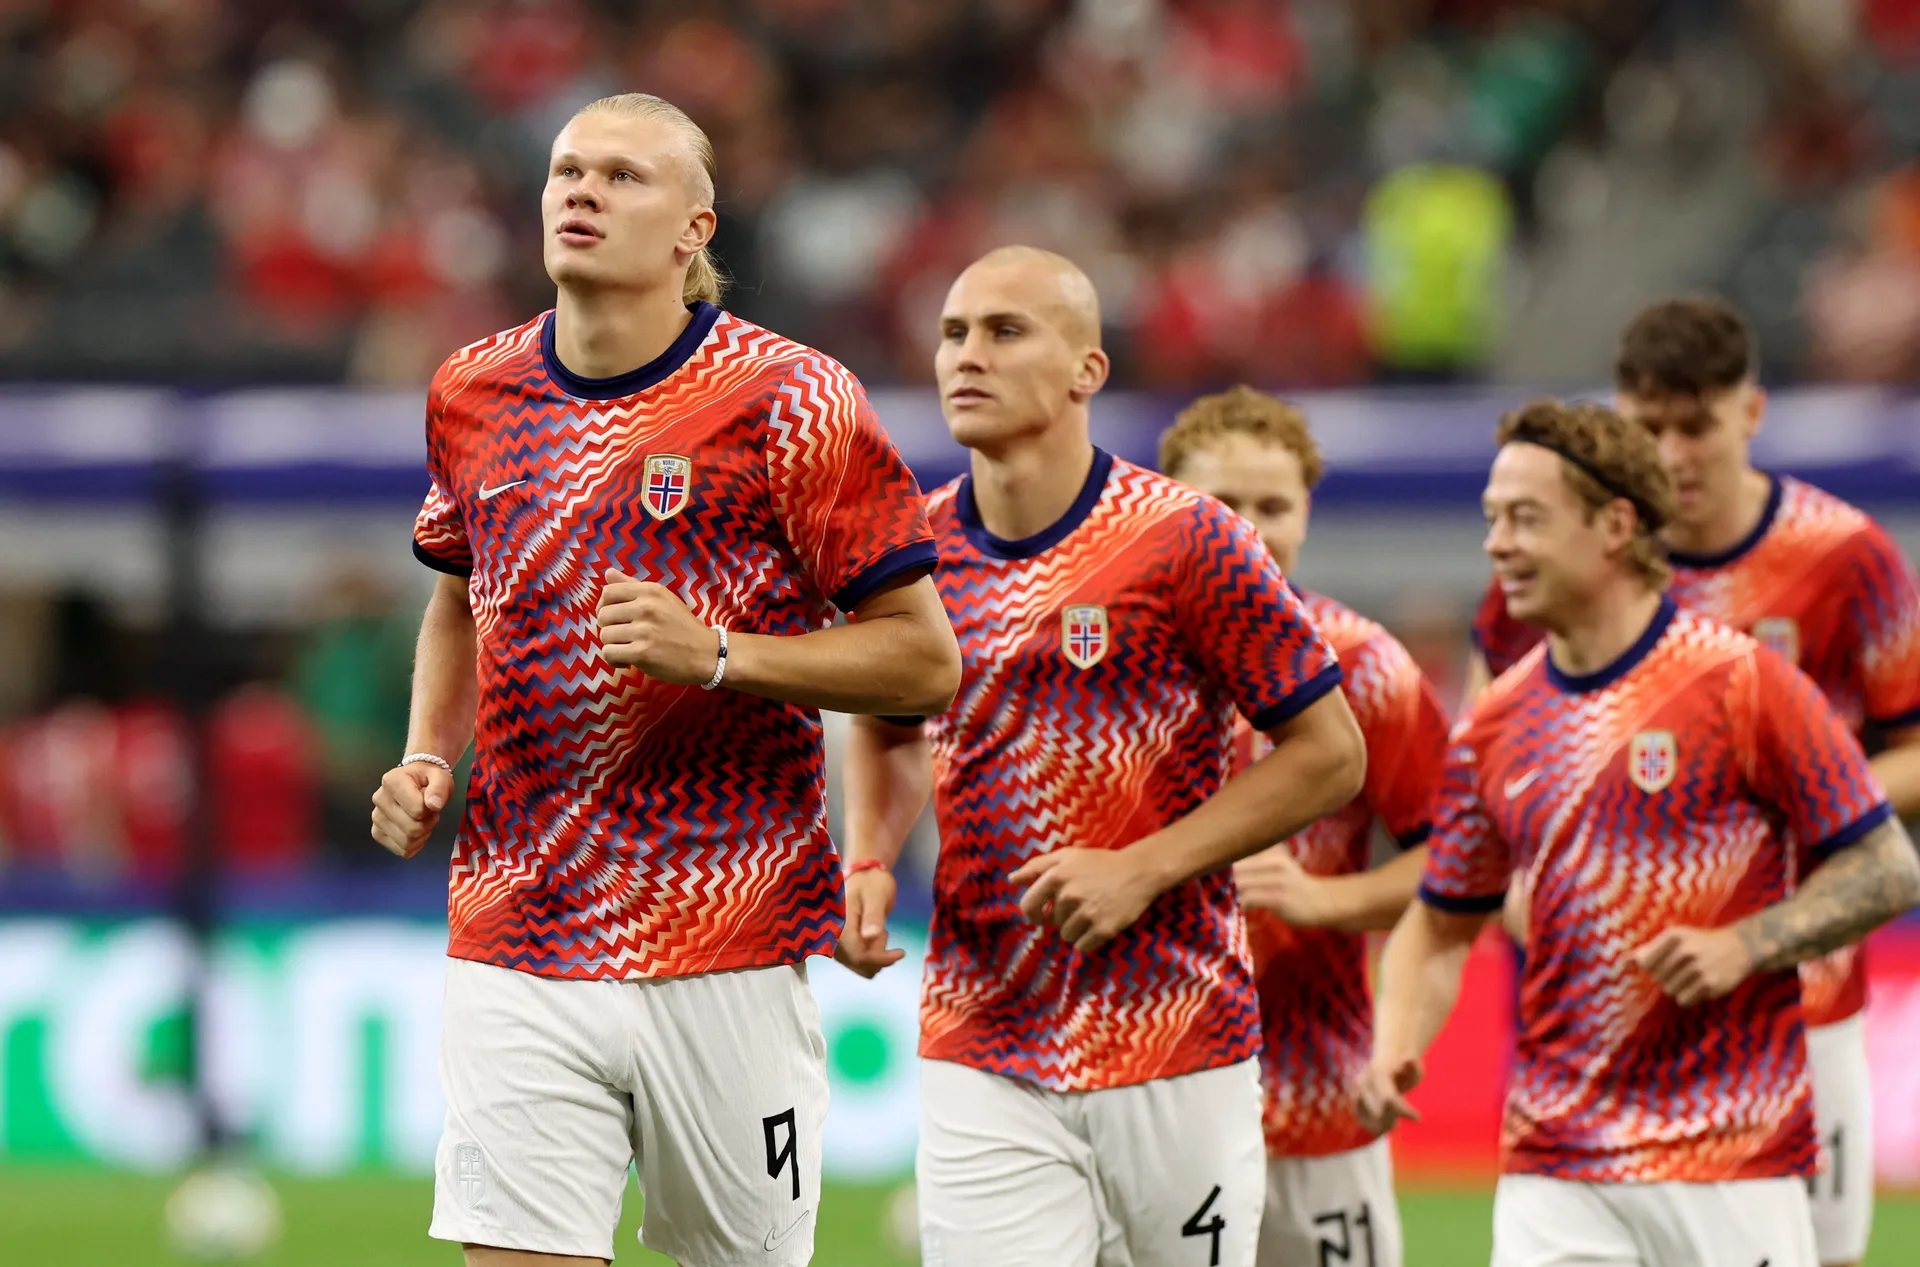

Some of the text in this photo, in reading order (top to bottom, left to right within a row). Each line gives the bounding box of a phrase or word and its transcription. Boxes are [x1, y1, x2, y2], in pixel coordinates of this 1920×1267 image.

[762, 1107, 800, 1201] 9
[1807, 1121, 1844, 1200] 1
[1181, 1184, 1225, 1267] 4
